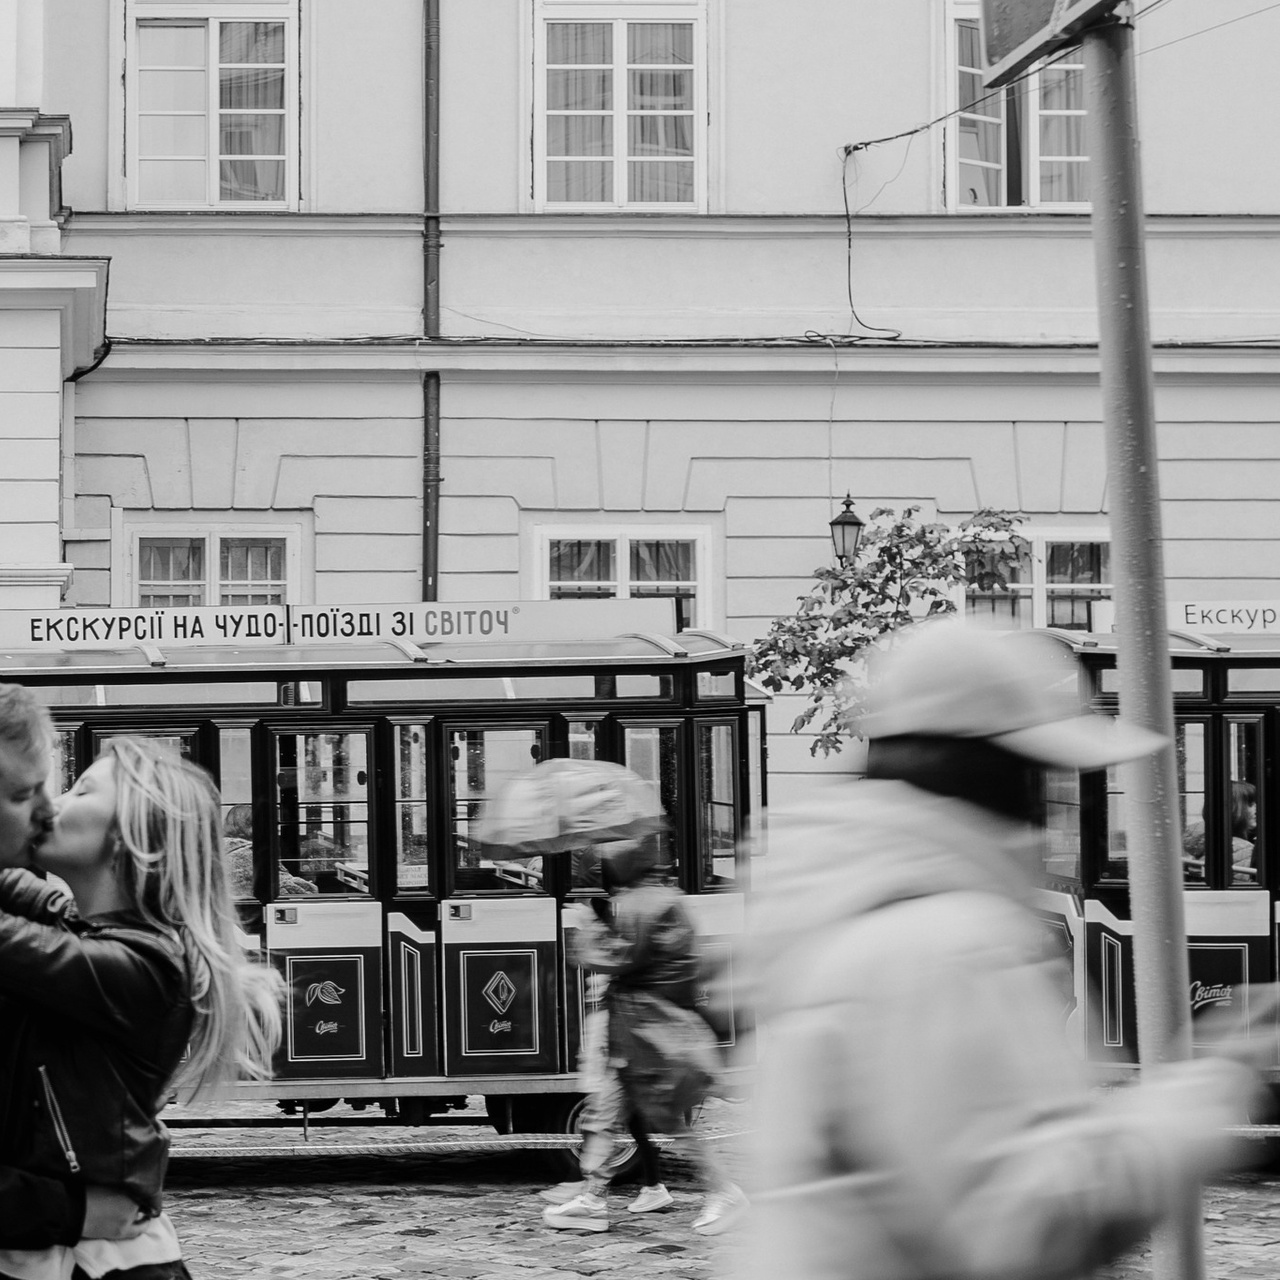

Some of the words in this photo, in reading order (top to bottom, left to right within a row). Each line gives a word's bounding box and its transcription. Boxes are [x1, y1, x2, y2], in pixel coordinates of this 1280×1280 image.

[30, 610, 165, 642] ЕКСКУРСІЇ
[173, 615, 205, 639] НА
[391, 611, 414, 637] ЗІ
[1184, 604, 1277, 629] Екскур
